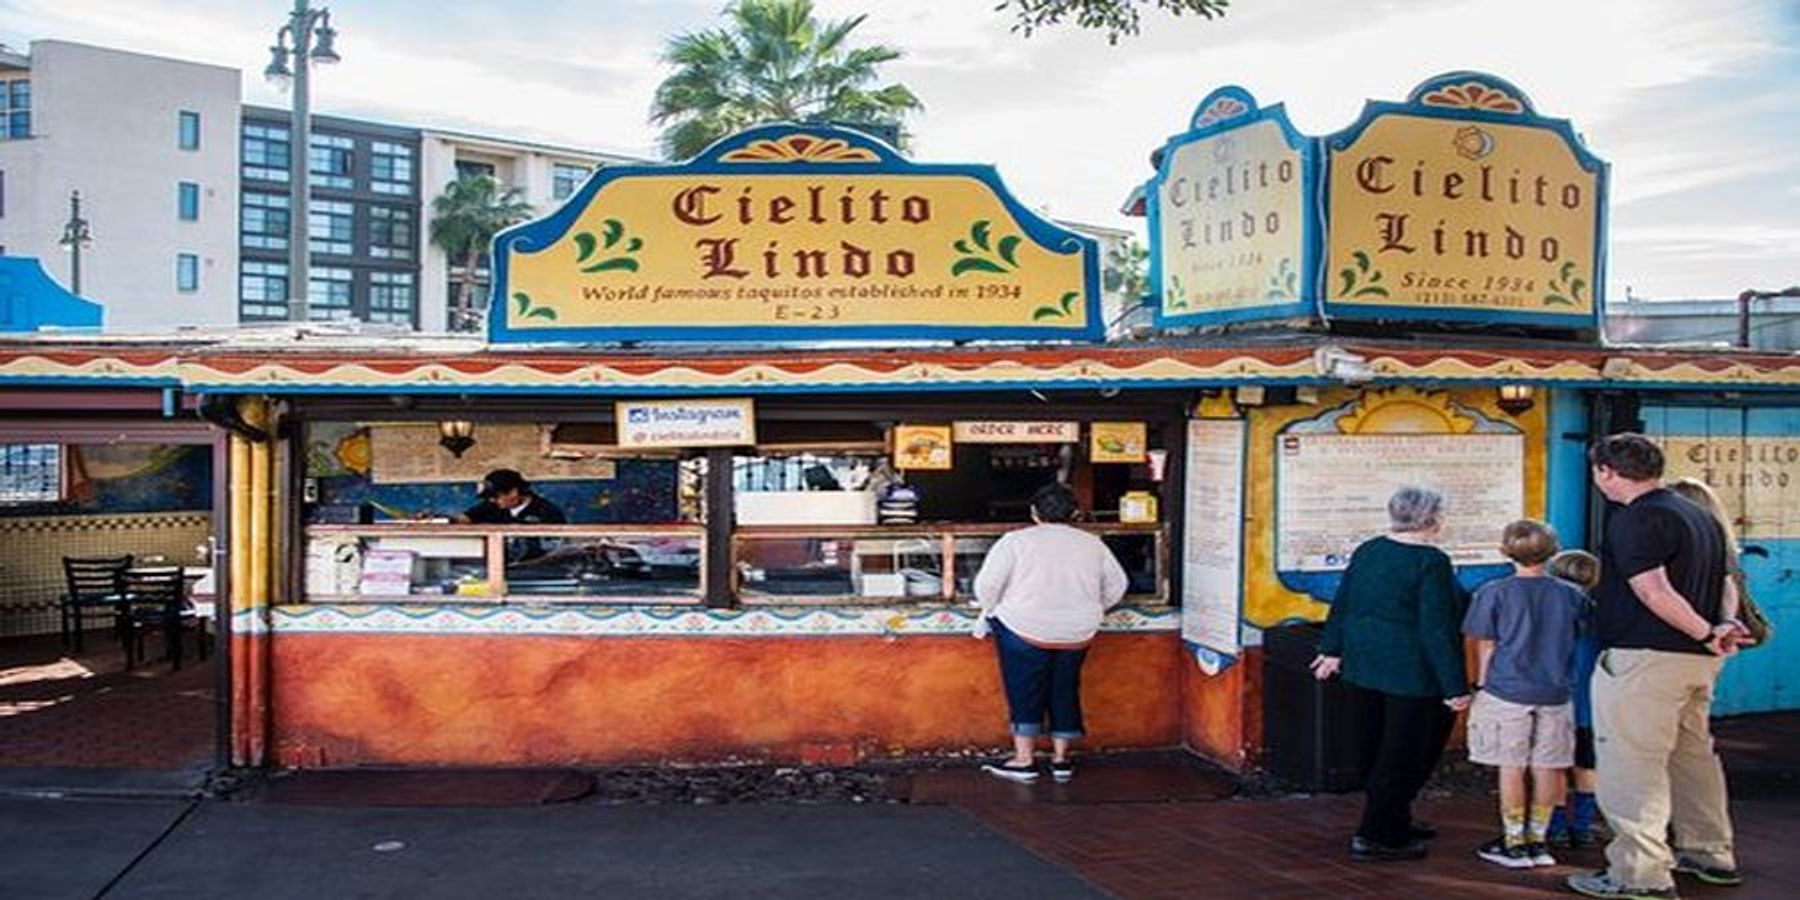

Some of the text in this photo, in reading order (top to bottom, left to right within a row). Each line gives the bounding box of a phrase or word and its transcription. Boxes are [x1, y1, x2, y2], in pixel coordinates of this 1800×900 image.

[1170, 159, 1293, 208] Cielito
[1355, 155, 1582, 210] Cielito
[671, 184, 932, 228] Cielito
[1180, 211, 1280, 250] Lindo
[1374, 212, 1561, 263] Lindo
[694, 237, 918, 281] Lindo
[1400, 271, 1471, 290] Since
[581, 282, 1022, 304] World famous taquitos established in 1934
[969, 423, 1064, 436] ORDER HERE
